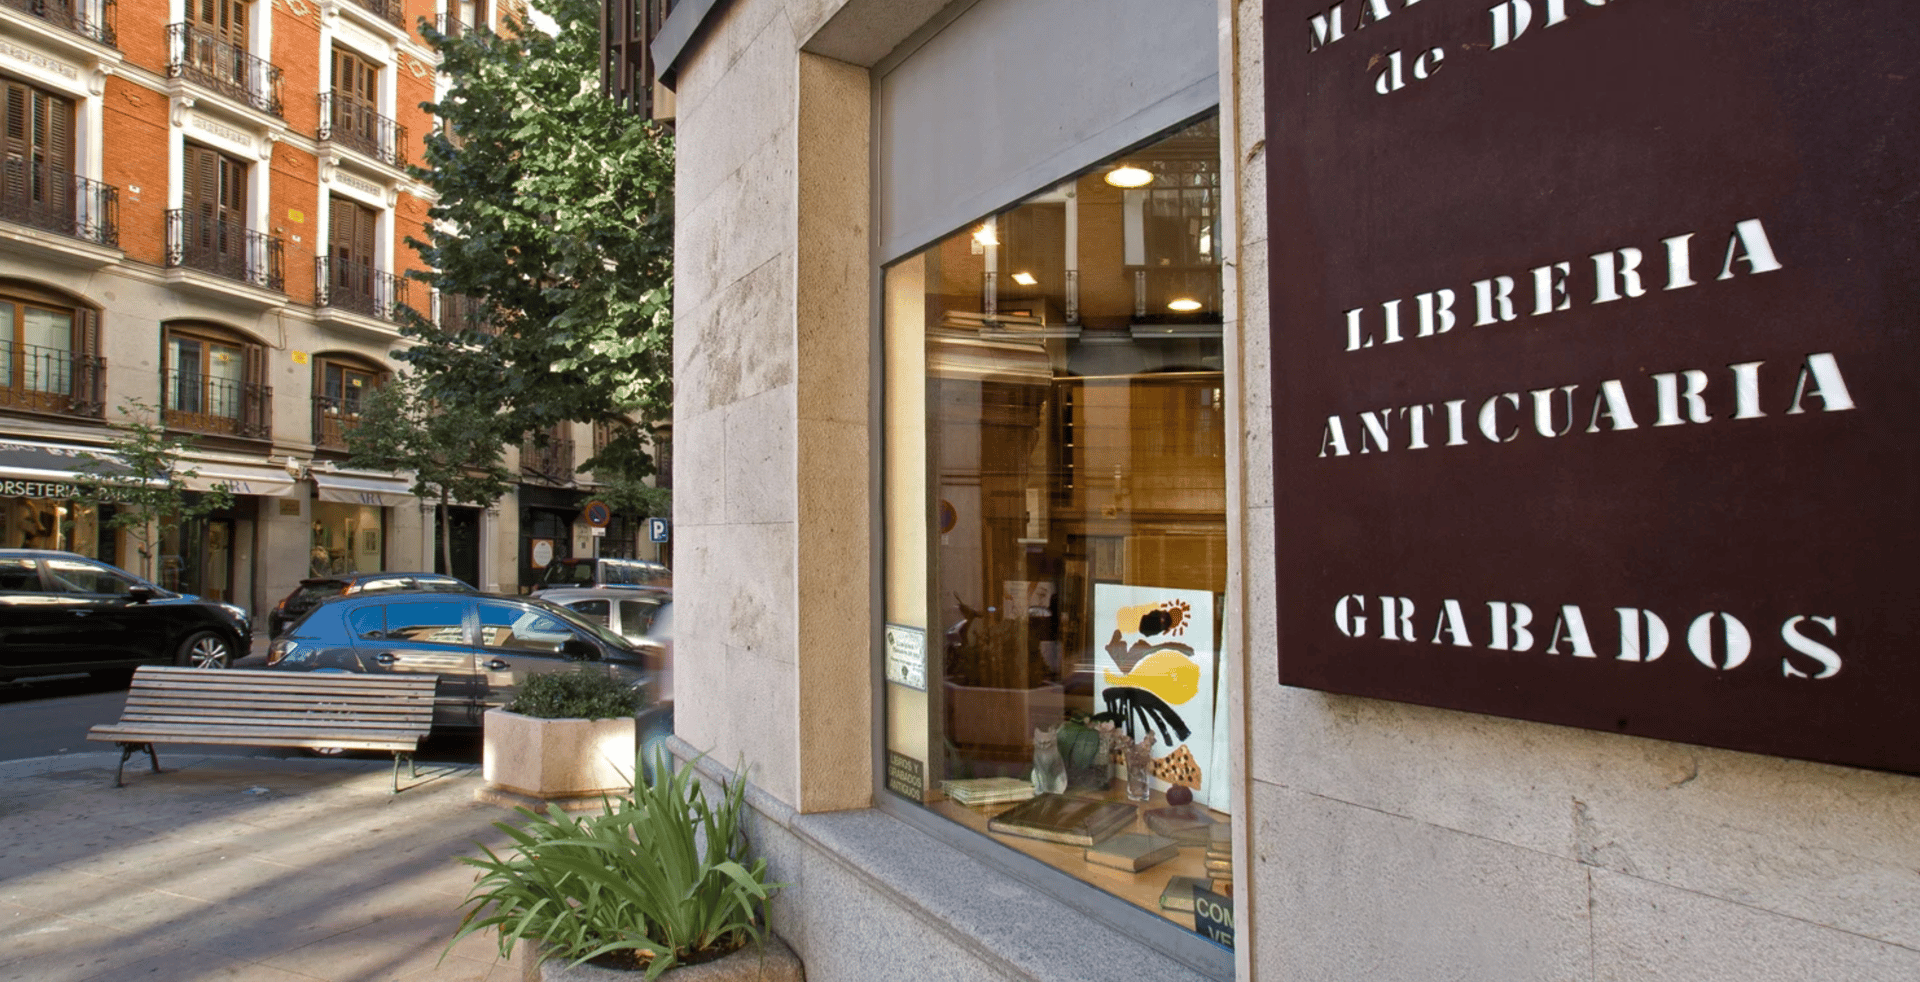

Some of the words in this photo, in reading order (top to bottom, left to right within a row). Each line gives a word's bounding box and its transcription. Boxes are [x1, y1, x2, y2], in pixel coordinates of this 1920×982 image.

[1307, 0, 1421, 53] MA
[1374, 47, 1446, 95] de
[1344, 218, 1784, 353] LIBRERIA
[1317, 352, 1857, 459] ANTICUARIA
[0, 481, 81, 498] RSETERIA
[653, 521, 665, 539] P
[1333, 594, 1843, 680] GRABADOS
